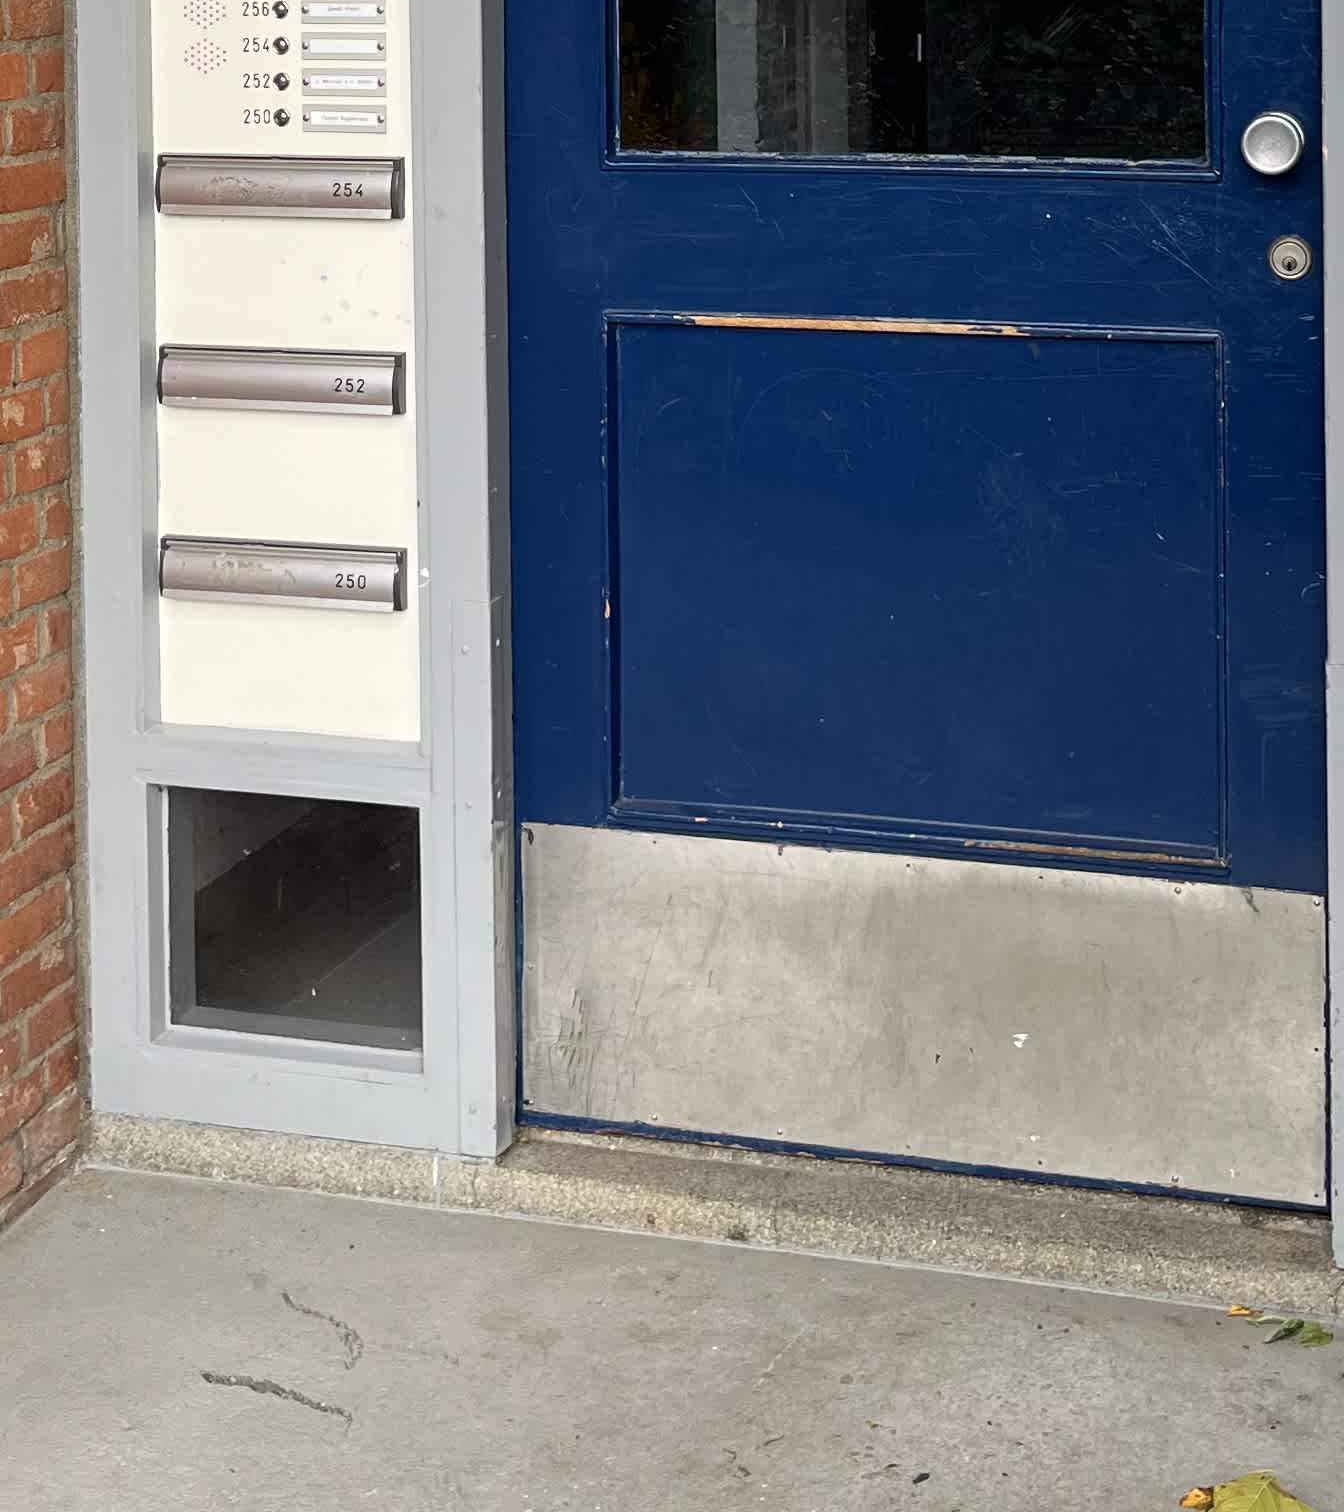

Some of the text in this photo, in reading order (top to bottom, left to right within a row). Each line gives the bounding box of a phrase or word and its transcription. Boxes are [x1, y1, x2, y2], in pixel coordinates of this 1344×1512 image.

[241, 1, 270, 17] 256
[242, 37, 270, 53] 254
[242, 73, 271, 89] 252
[243, 109, 272, 125] 250
[332, 182, 363, 197] 254
[334, 378, 365, 393] 252
[335, 573, 367, 590] 250
